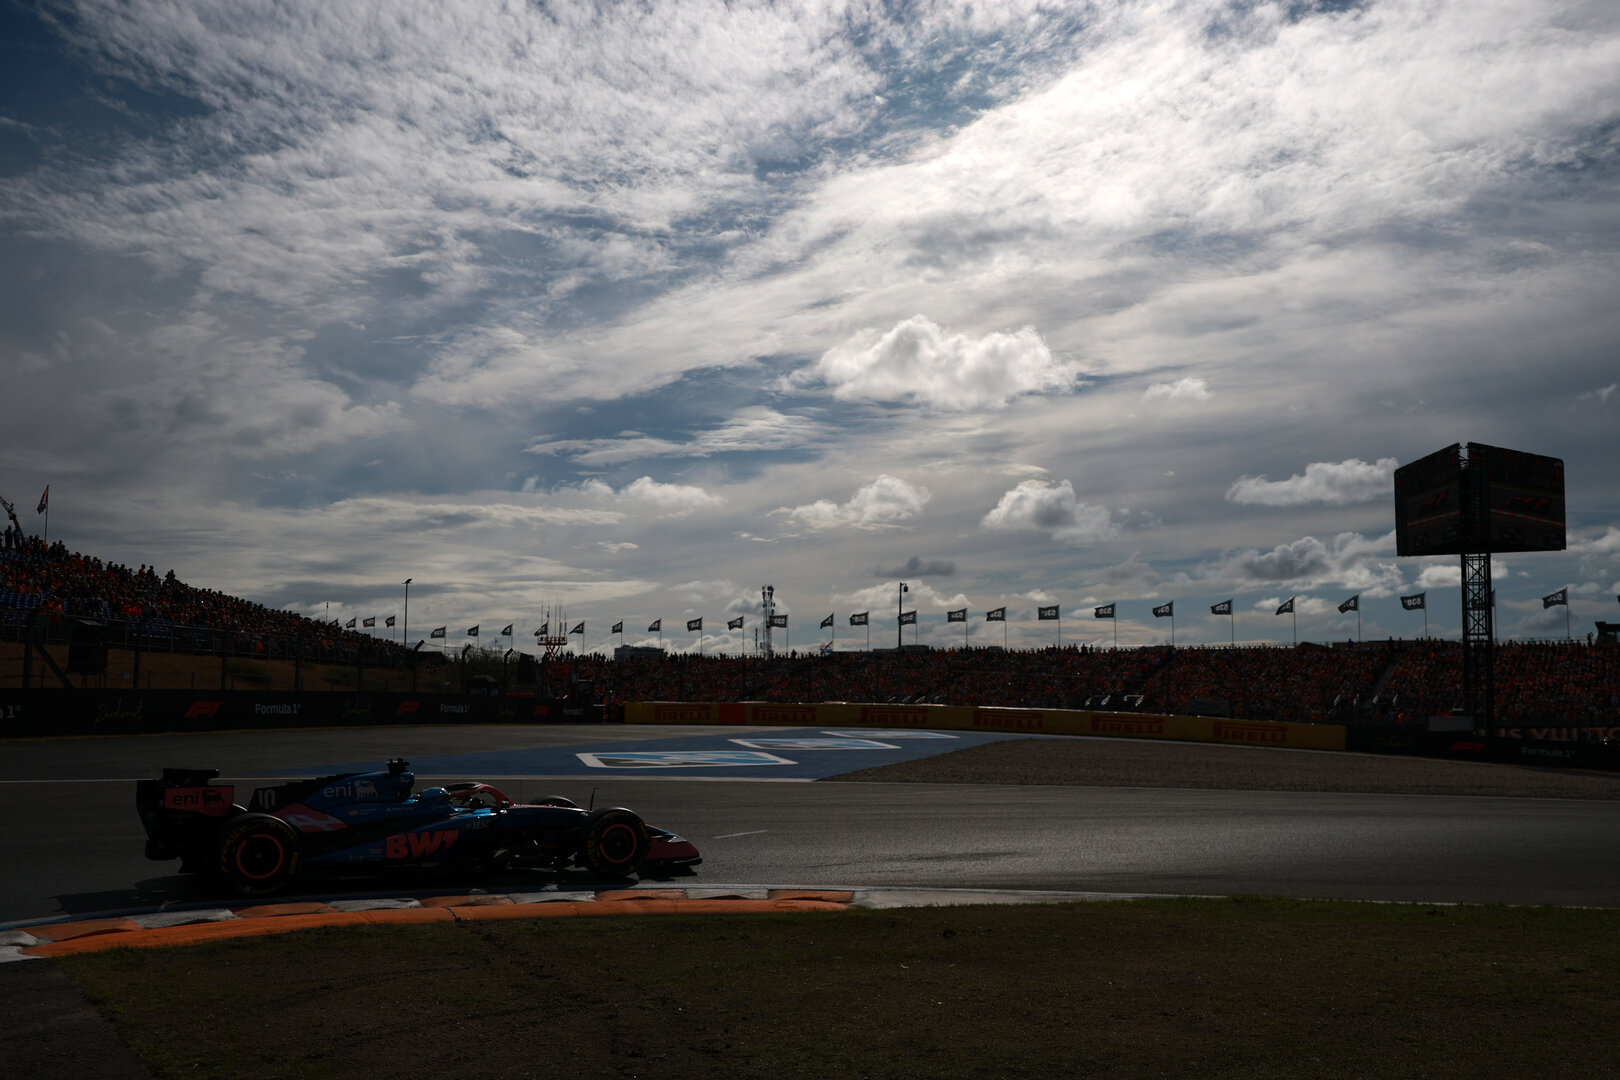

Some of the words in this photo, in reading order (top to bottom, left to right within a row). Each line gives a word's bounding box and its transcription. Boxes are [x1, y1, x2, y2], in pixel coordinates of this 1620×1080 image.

[255, 703, 292, 715] Formula
[440, 703, 464, 714] Formula
[655, 705, 711, 721] PIRELLI
[752, 706, 817, 722] PIRELLI
[860, 707, 928, 723] PIRELLI
[973, 710, 1044, 729] PIRELLI
[1091, 715, 1165, 734] PIRELLI
[1213, 722, 1288, 742] PIRELLI
[1520, 747, 1564, 757] Formula
[172, 791, 199, 805] eni
[323, 782, 353, 798] eni
[257, 789, 276, 810] 10
[385, 829, 460, 860] BWT
